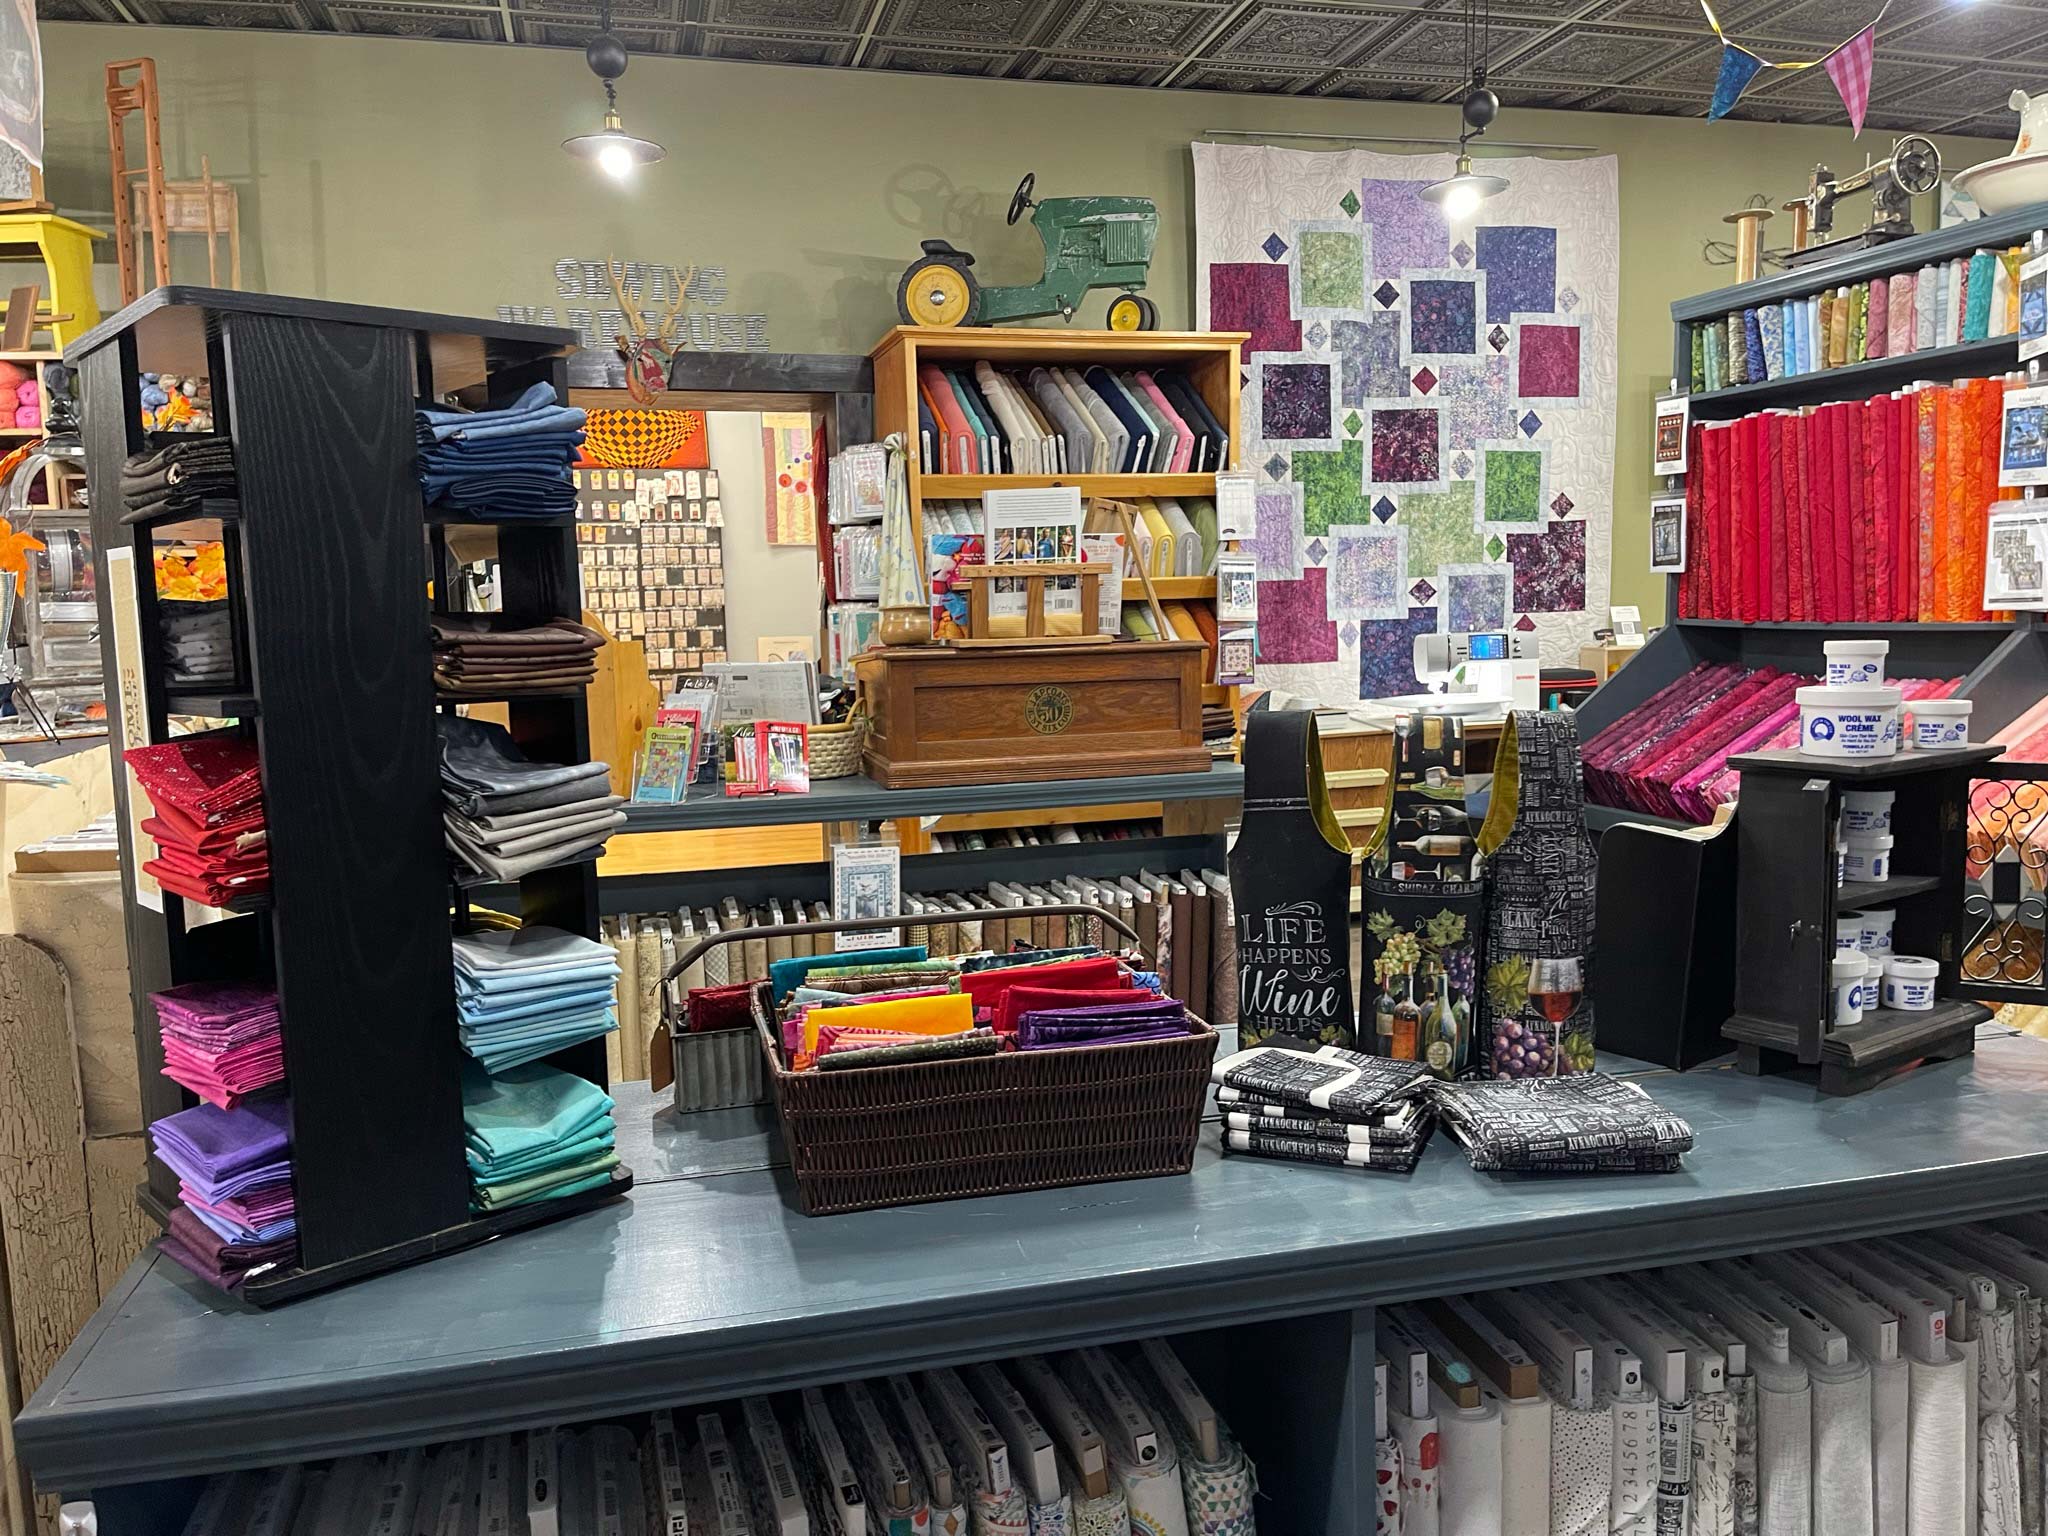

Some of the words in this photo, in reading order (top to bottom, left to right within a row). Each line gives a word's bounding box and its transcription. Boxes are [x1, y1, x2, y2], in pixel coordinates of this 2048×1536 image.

[1398, 882, 1435, 894] SHIRAZ
[1241, 914, 1326, 944] LIFE
[1502, 911, 1537, 929] BLANC
[1541, 920, 1571, 938] Pinot
[1240, 947, 1332, 965] HAPPENS
[1239, 964, 1341, 1017] Wine
[1256, 1014, 1323, 1033] HELPS
